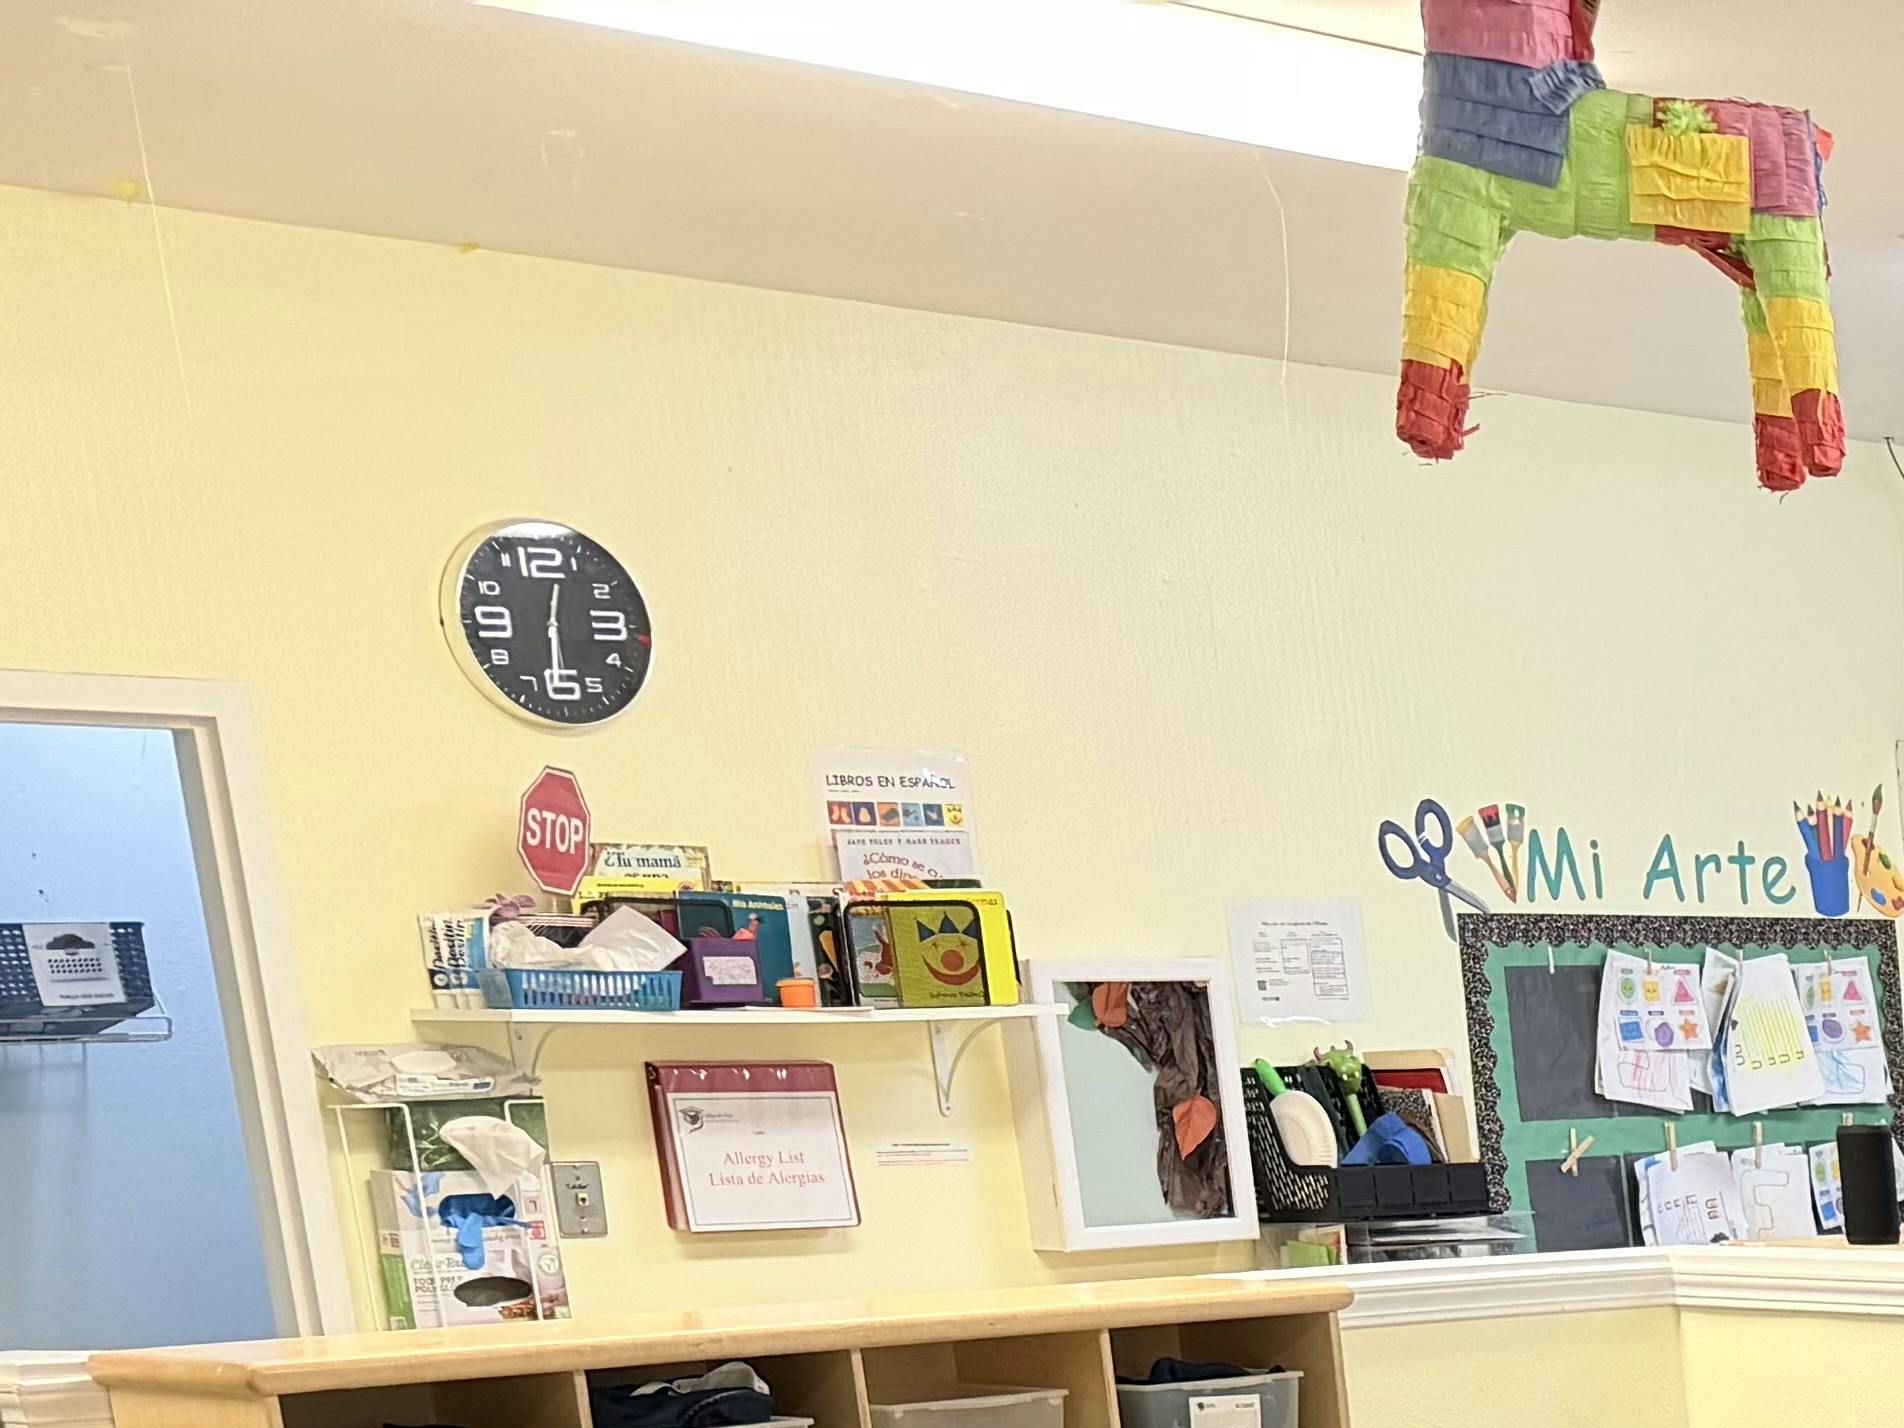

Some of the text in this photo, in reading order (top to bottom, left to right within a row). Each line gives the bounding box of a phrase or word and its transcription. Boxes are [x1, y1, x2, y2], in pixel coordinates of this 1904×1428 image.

[517, 546, 566, 579] 12
[478, 580, 501, 596] 10
[591, 583, 611, 600] 2
[474, 605, 513, 639] 9
[589, 609, 628, 641] 3
[490, 649, 510, 665] 8
[605, 652, 623, 668] 4
[519, 675, 538, 692] 7
[543, 668, 581, 700] 6
[584, 677, 604, 693] 5
[825, 774, 874, 788] LIBROS
[877, 775, 896, 789] EN
[525, 807, 585, 855] STOP
[635, 855, 682, 869] mamá
[863, 852, 910, 866] ¿Cómo
[1526, 825, 1798, 906] Mi Arte
[723, 1151, 806, 1167] Allergy List
[709, 1172, 826, 1187] Lista de Alergias
